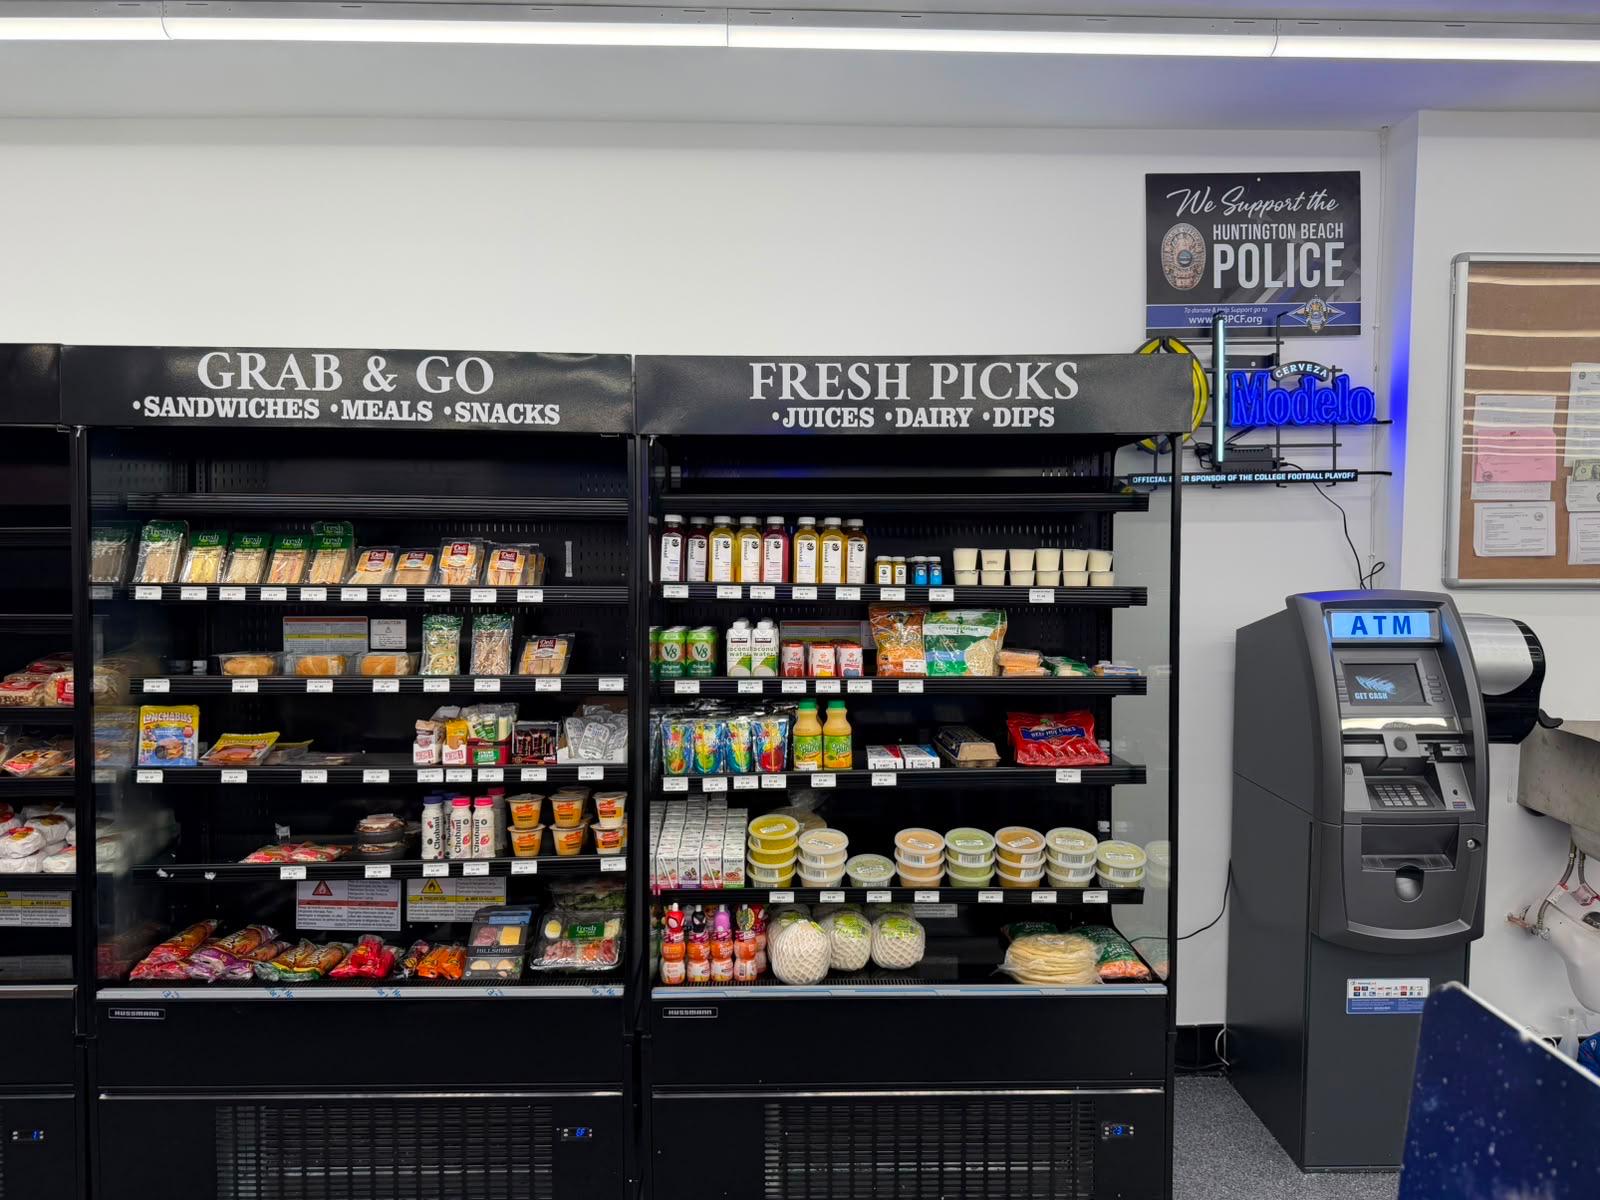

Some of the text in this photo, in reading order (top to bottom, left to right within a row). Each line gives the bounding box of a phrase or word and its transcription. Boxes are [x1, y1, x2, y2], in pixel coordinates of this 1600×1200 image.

[1166, 185, 1340, 218] We Support the
[1213, 222, 1344, 240] HUNTINGTON BEACH
[1213, 242, 1345, 289] POLICE
[1230, 306, 1253, 315] Support
[1253, 307, 1261, 315] go
[197, 352, 494, 395] GRAB & GO
[1275, 362, 1328, 378] CERVEZA
[749, 361, 1079, 400] FRESH PICKS
[1231, 371, 1375, 426] Modelo
[144, 396, 560, 425] SANDWICHES MEALS SNACKS
[783, 406, 1055, 428] JUICES DAIRY DIPS
[1132, 476, 1167, 484] OFFICIAL
[1190, 474, 1227, 482] SPONSOR
[1227, 474, 1238, 482] OF
[1254, 473, 1286, 481] COLLEGE
[1287, 472, 1324, 480] FOOTBALL
[1324, 471, 1356, 480] PLAYOFF
[1350, 615, 1412, 635] ATM
[664, 644, 678, 659] V8
[695, 644, 709, 659] V8
[1354, 692, 1389, 700] GET CASH
